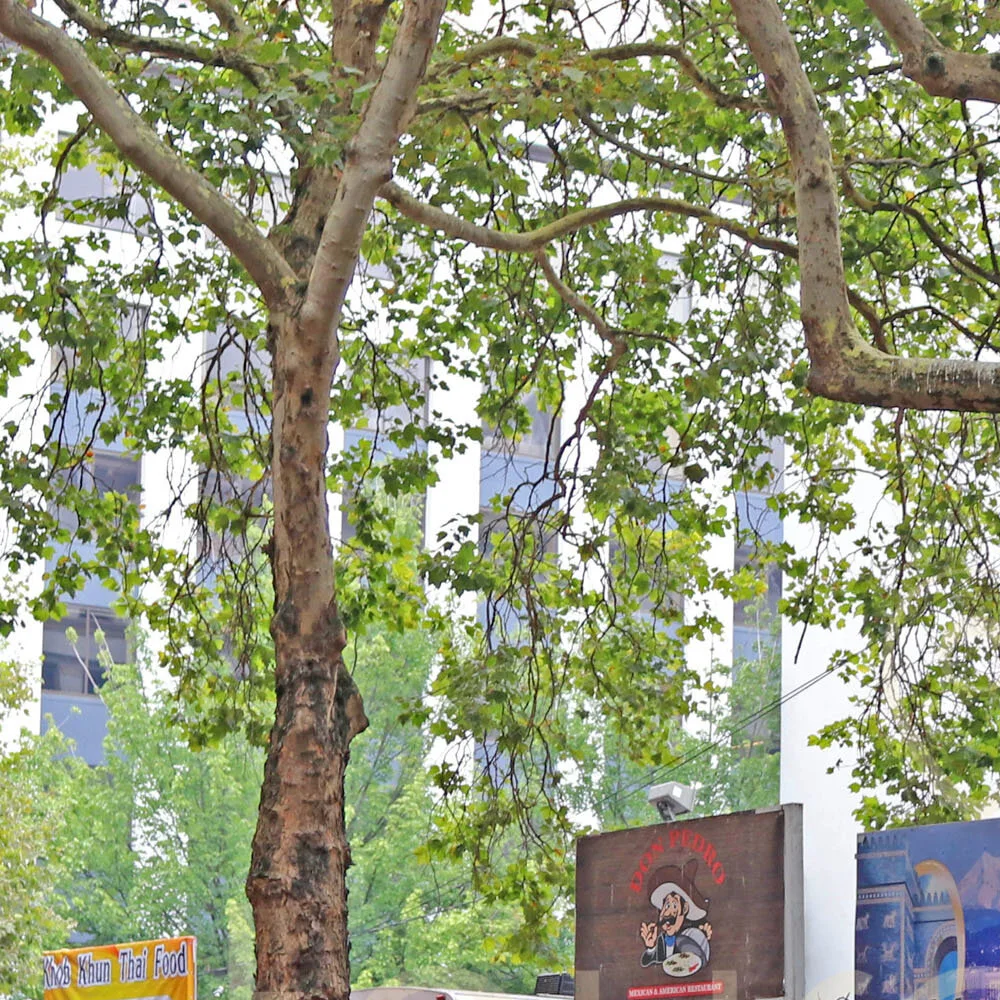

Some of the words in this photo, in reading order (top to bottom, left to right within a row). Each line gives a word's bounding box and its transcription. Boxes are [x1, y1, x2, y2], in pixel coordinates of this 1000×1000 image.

[630, 836, 665, 893] DON
[668, 829, 726, 885] PEDRO
[43, 955, 71, 987] Khob
[78, 952, 111, 986] Khun
[119, 947, 149, 982] Thai
[155, 941, 187, 977] Food
[628, 988, 653, 998] MEXICAN
[659, 985, 687, 995] AMERICAN
[687, 982, 722, 993] RESTAURANT
